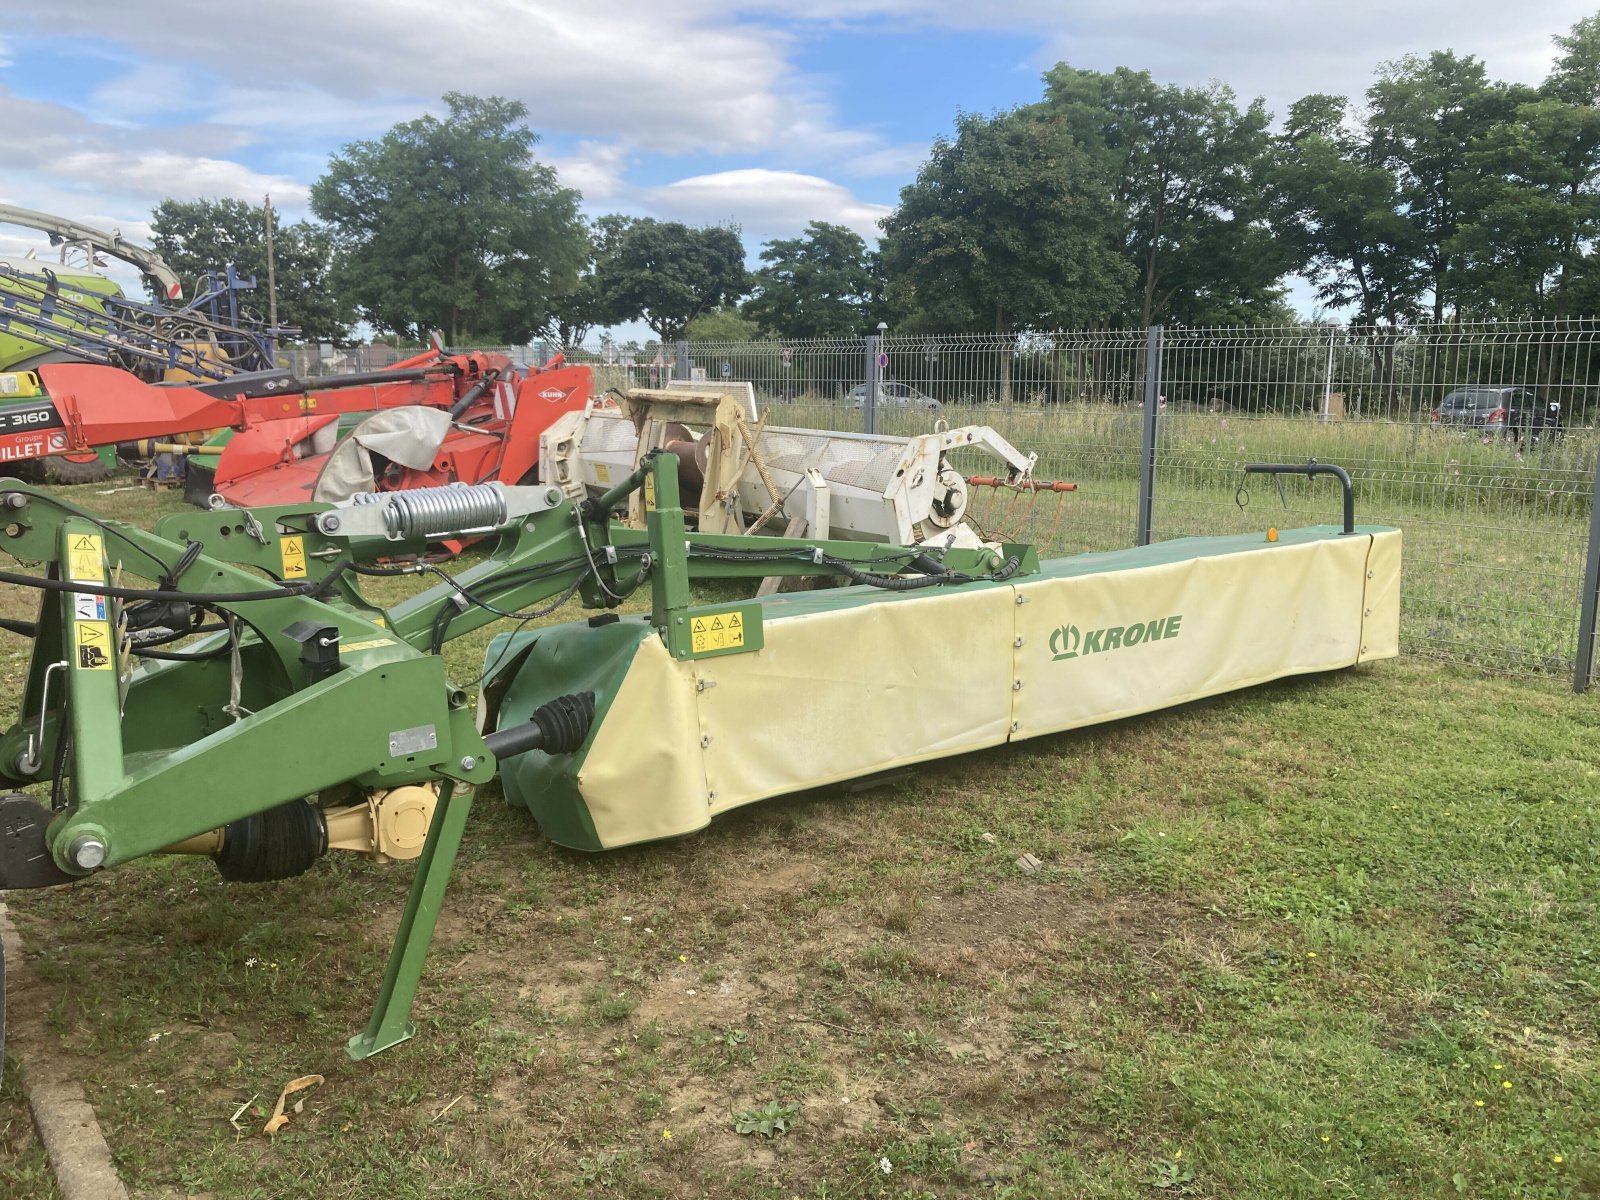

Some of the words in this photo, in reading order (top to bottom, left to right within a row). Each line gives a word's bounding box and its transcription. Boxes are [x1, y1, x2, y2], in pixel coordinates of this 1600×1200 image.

[11, 411, 50, 426] 3160
[15, 434, 44, 443] Groupe
[1082, 614, 1183, 656] KRONE
